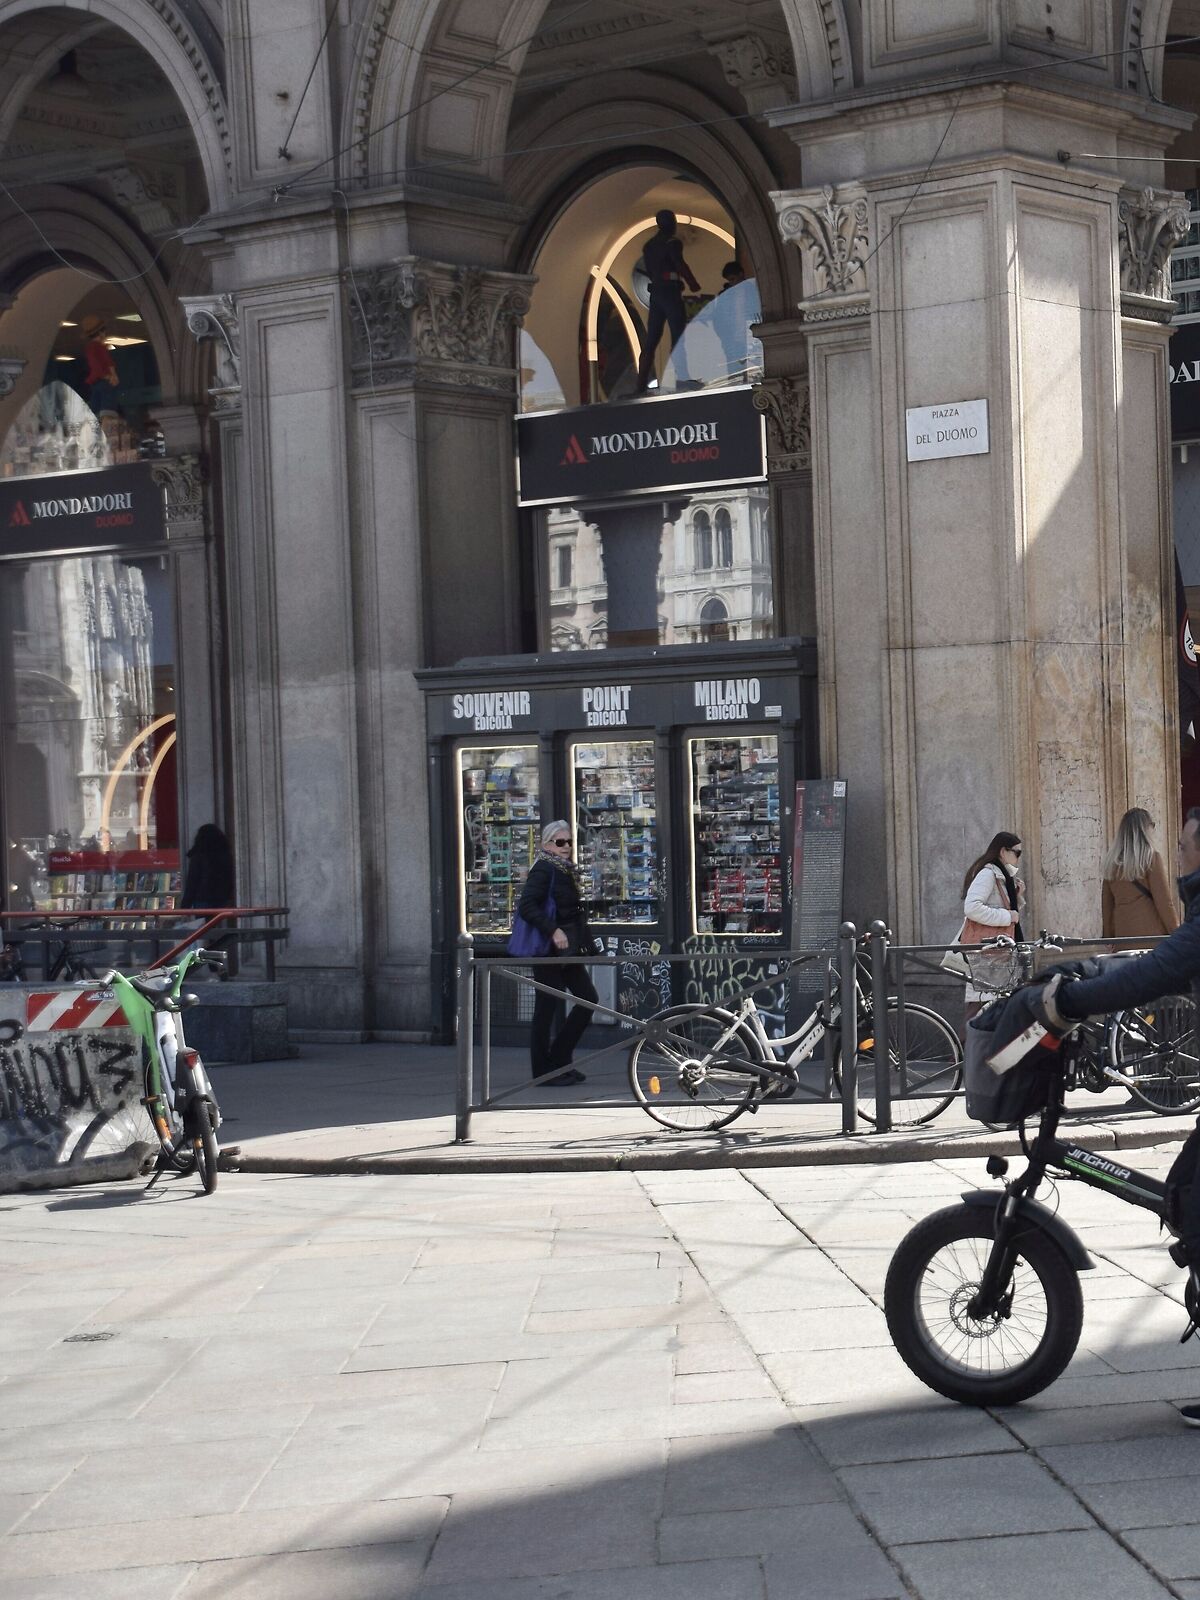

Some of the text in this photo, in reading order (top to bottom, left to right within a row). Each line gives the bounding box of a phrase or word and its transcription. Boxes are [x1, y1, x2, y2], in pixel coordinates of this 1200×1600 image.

[932, 408, 960, 419] PIAZZA
[590, 422, 719, 455] MONDADORI
[916, 426, 978, 445] DEL DUOMO
[671, 446, 720, 464] DUOMO
[33, 492, 133, 518] MONDADORI
[96, 514, 134, 528] DUOMO
[583, 685, 632, 712] POINT
[695, 678, 760, 706] MILANO
[453, 690, 531, 718] SOUVENIR
[706, 704, 748, 720] EDICOLA
[475, 715, 512, 731] EDICOLA
[587, 710, 628, 726] EDICOLA
